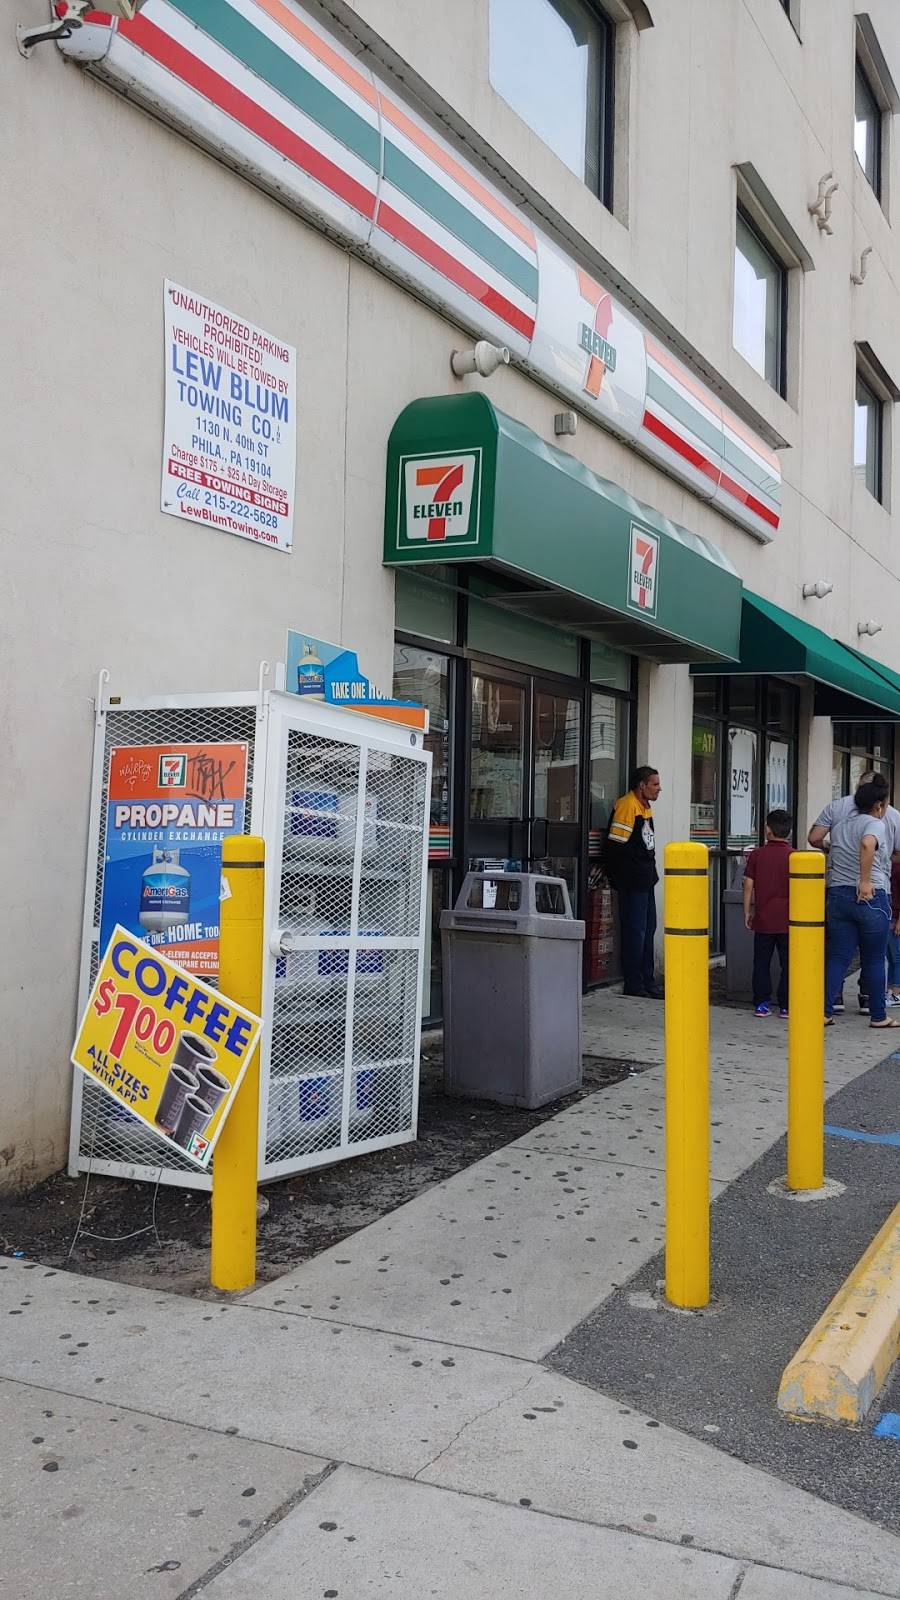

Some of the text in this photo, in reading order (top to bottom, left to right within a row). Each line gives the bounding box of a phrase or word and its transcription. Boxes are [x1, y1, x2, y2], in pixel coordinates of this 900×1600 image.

[172, 290, 289, 363] UNAUTHORIZED PARKING
[204, 323, 263, 365] PROHIBITED!
[173, 326, 288, 395] VEHICLES WILL BE TOWED BY
[172, 343, 289, 423] LEW BLUM
[177, 380, 242, 427] TOWING
[252, 415, 274, 442] CO.
[196, 416, 269, 457] 1130 N. 40th ST
[172, 444, 198, 467] Charge
[200, 456, 218, 472] $175
[228, 466, 240, 481] $25
[242, 472, 247, 482] A
[249, 474, 260, 491] Day
[263, 480, 287, 500] Storage
[231, 450, 242, 467] PA
[245, 457, 271, 478] 19104
[171, 464, 286, 514] FREE TOWING SIGNS
[176, 482, 278, 529] Call 215-222-5628
[180, 501, 279, 544] LewBlumTowing.com
[331, 682, 350, 699] TAKE
[351, 682, 365, 699] ONE
[115, 803, 235, 828] PROPANE
[121, 831, 225, 841] CYLINDER EXCHANGE
[151, 932, 165, 945] ONE
[168, 922, 203, 943] HOME
[191, 951, 218, 959] ACCEPTS
[111, 941, 252, 1057] COFFEE
[87, 1045, 108, 1069] ALL
[112, 1063, 150, 1100] SIZES
[92, 1061, 137, 1104] WITH APP
